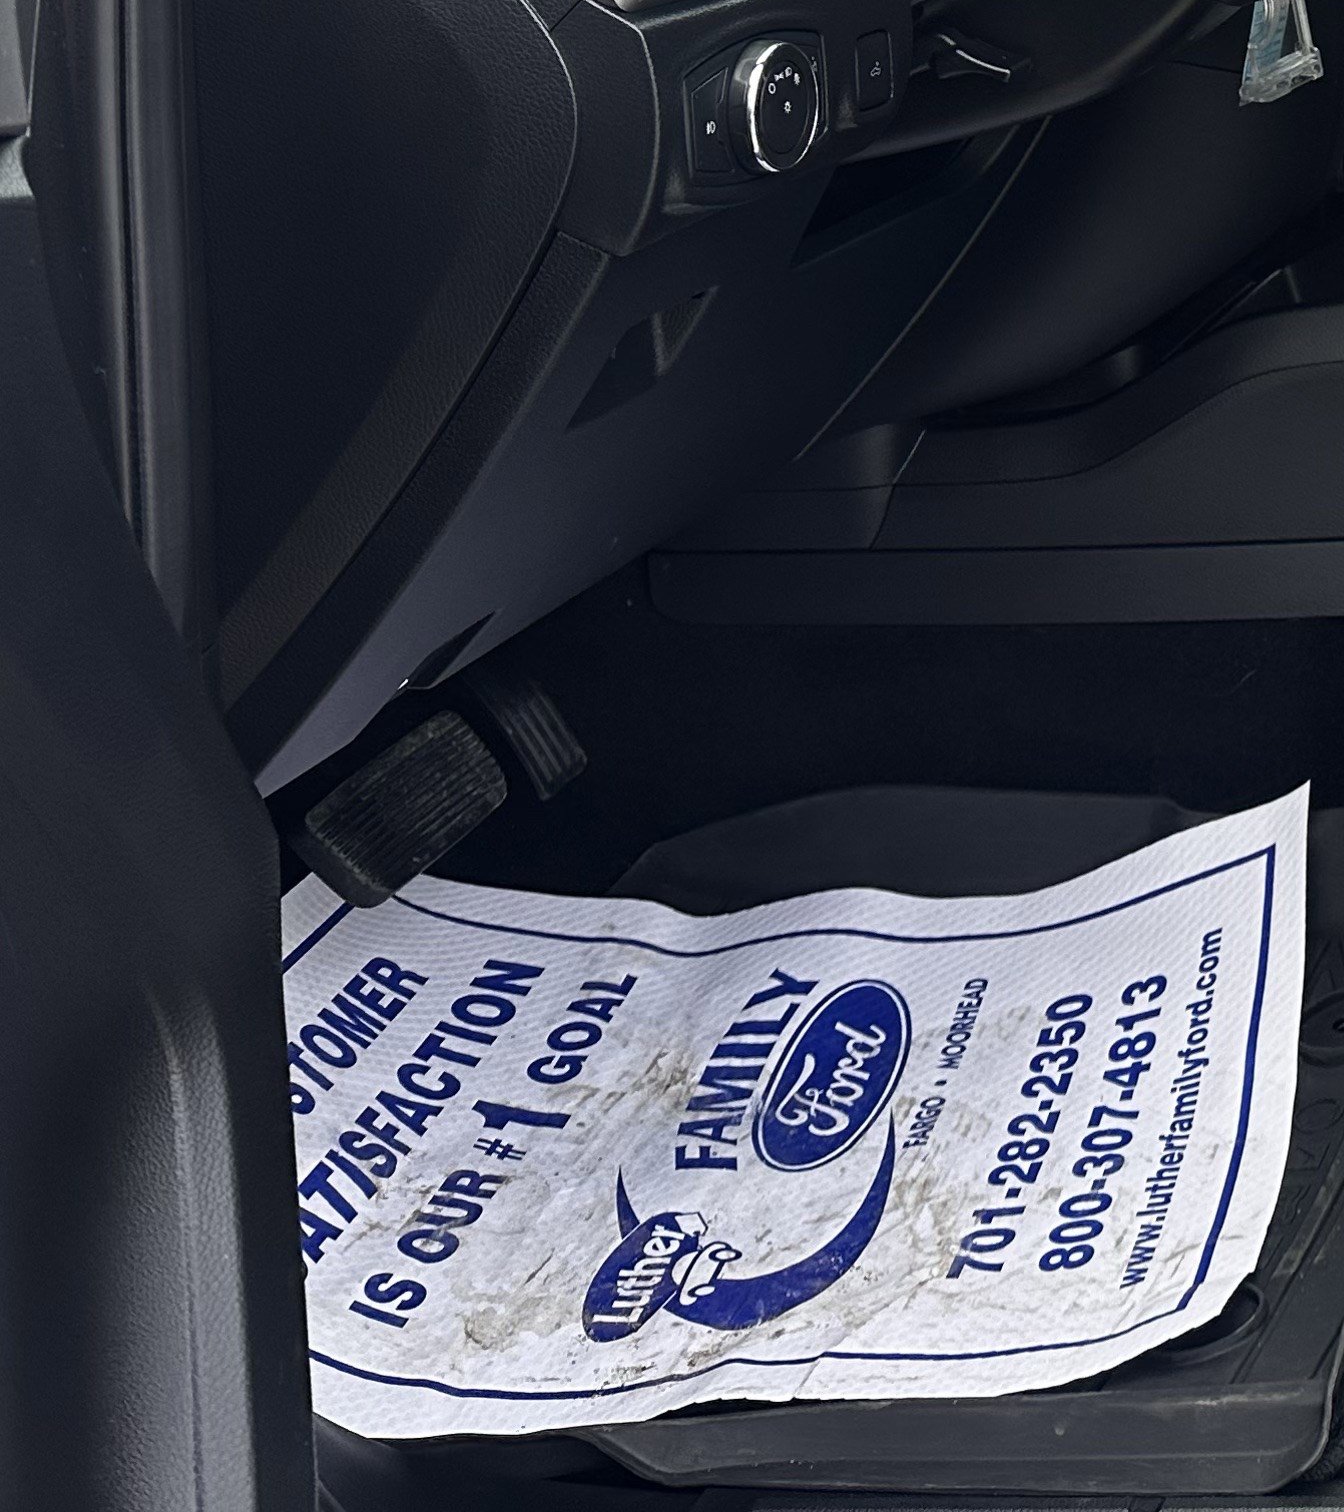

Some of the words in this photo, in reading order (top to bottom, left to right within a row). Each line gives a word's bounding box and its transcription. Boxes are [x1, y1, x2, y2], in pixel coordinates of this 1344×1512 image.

[348, 1272, 428, 1329] IS
[396, 1169, 515, 1264] OUR
[472, 1099, 572, 1162] #1
[526, 974, 638, 1085] GOAL
[675, 968, 821, 1172] FAMILY
[775, 1021, 888, 1138] Ford
[902, 1095, 946, 1150] FARGO
[938, 977, 989, 1070] MOORHEAD
[946, 993, 1094, 1280] 701-282-2350
[1038, 974, 1168, 1273] 800-307-4813
[1119, 927, 1223, 1290] www.lutherfamilyford.com
[592, 1223, 688, 1326] Luther
